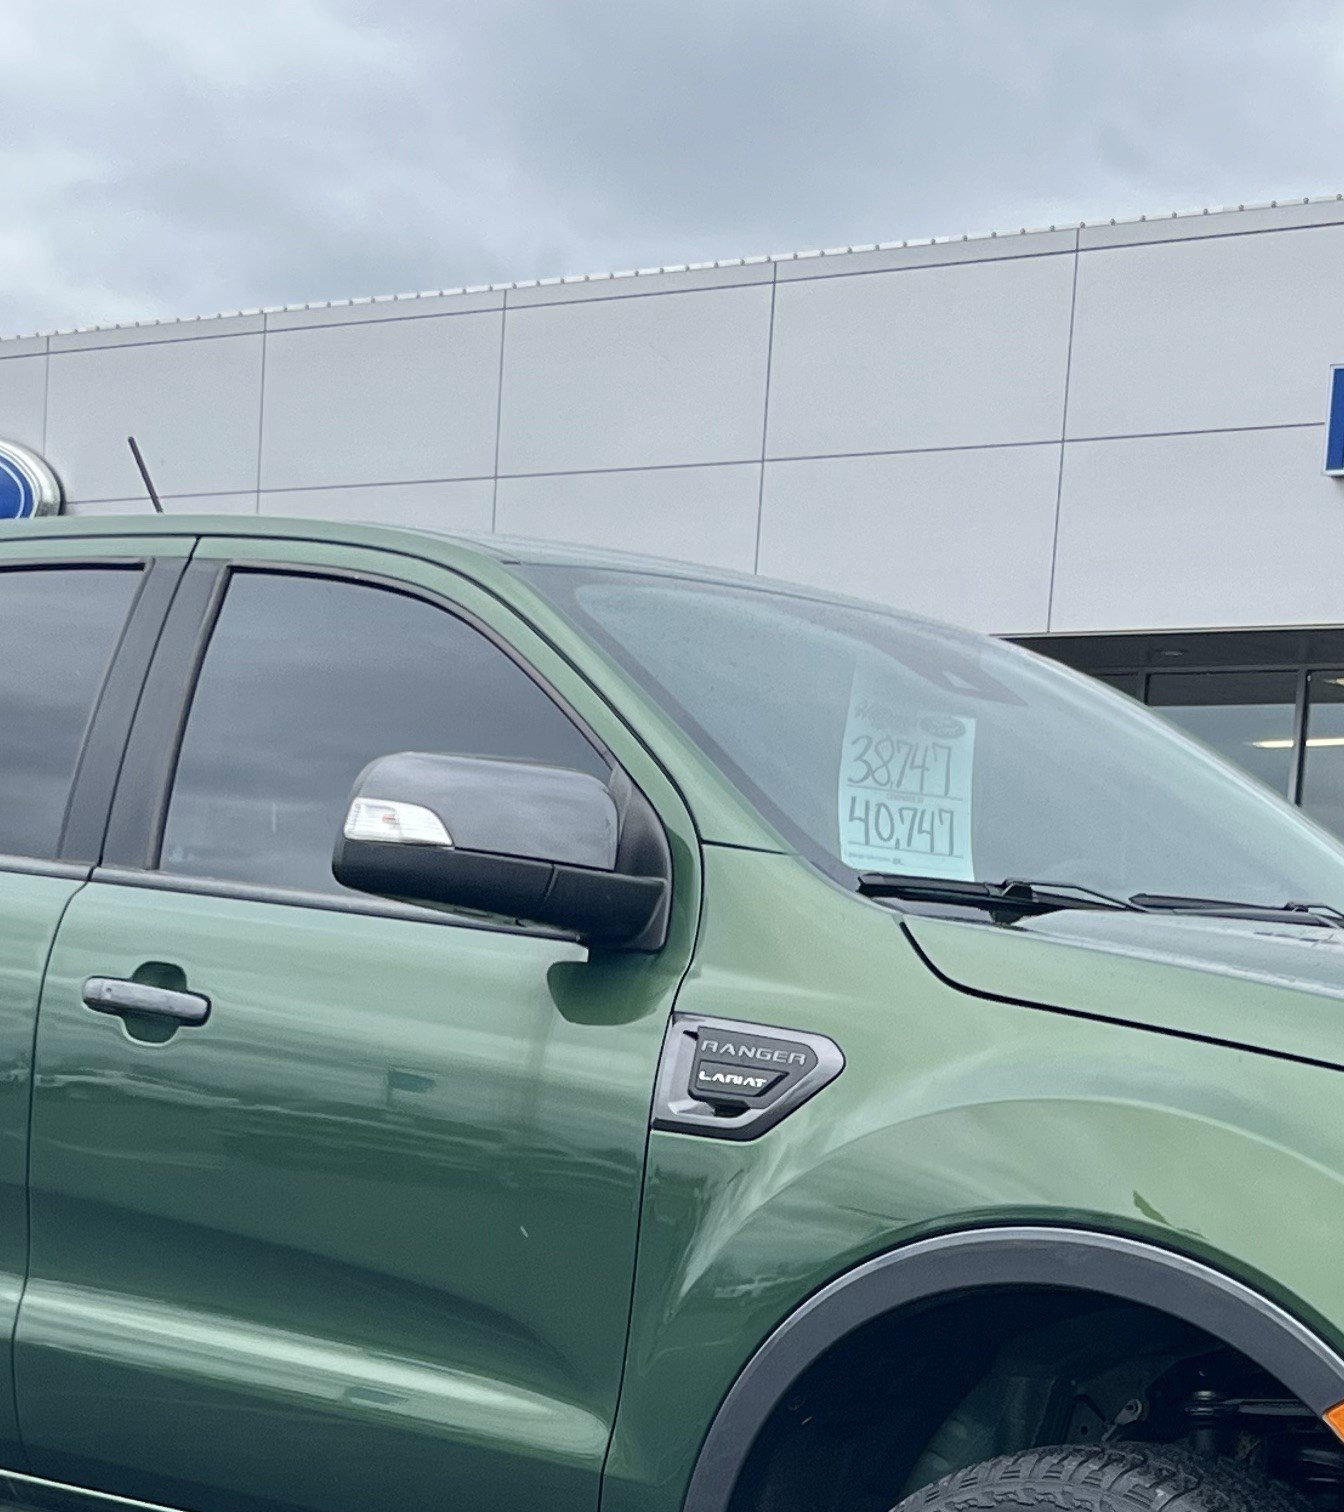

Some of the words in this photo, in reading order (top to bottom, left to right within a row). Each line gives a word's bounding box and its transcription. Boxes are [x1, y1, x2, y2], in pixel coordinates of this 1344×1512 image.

[848, 796, 955, 857] 40,747
[700, 1039, 807, 1066] RANGER
[698, 1070, 768, 1088] LARIAT
